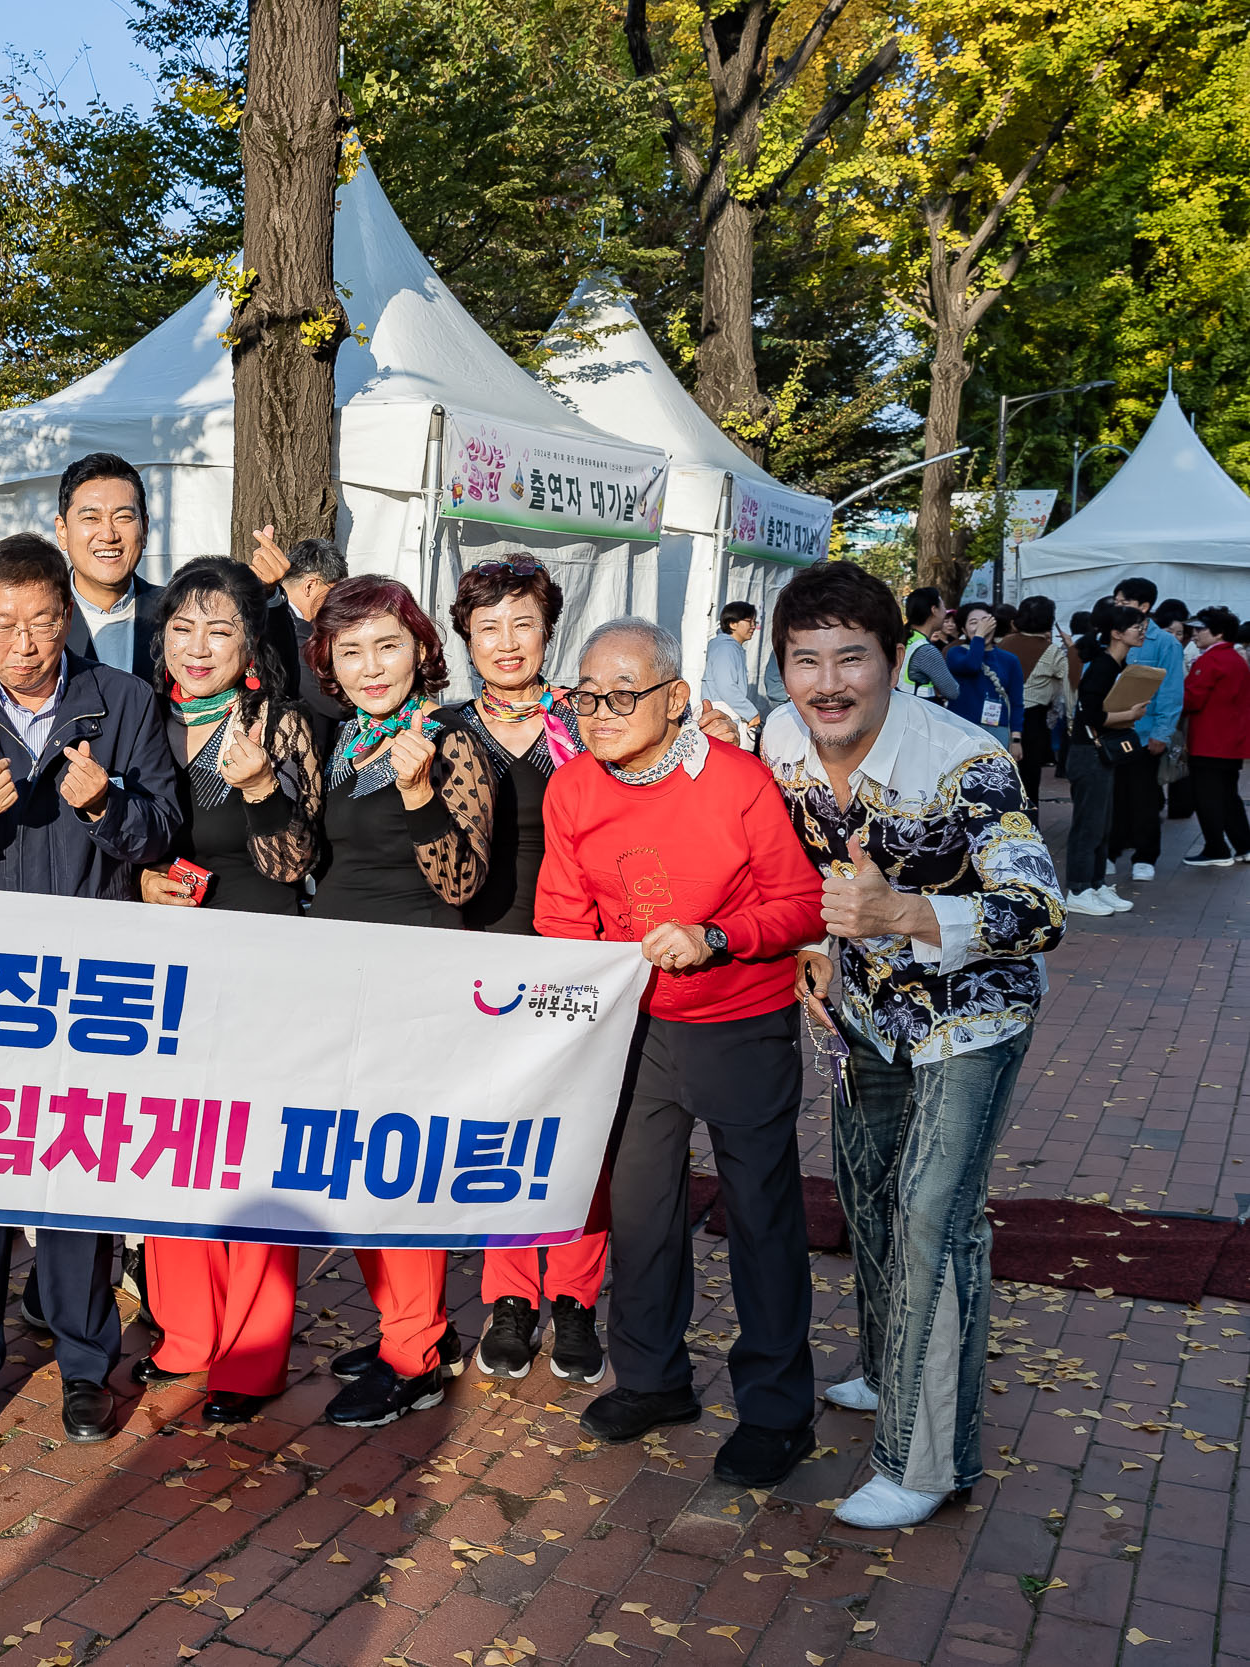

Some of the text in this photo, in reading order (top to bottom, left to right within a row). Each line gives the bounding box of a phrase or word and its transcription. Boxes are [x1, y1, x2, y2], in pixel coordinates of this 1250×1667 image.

[465, 436, 506, 469] 신나는
[464, 464, 501, 503] 광진
[528, 468, 639, 522] 출연자 대기실
[766, 515, 818, 555] 출연자 대기실
[528, 995, 598, 1022] 행복광진
[531, 983, 599, 999] 소통하며 발전하는
[272, 1106, 561, 1204] 파이팅!
